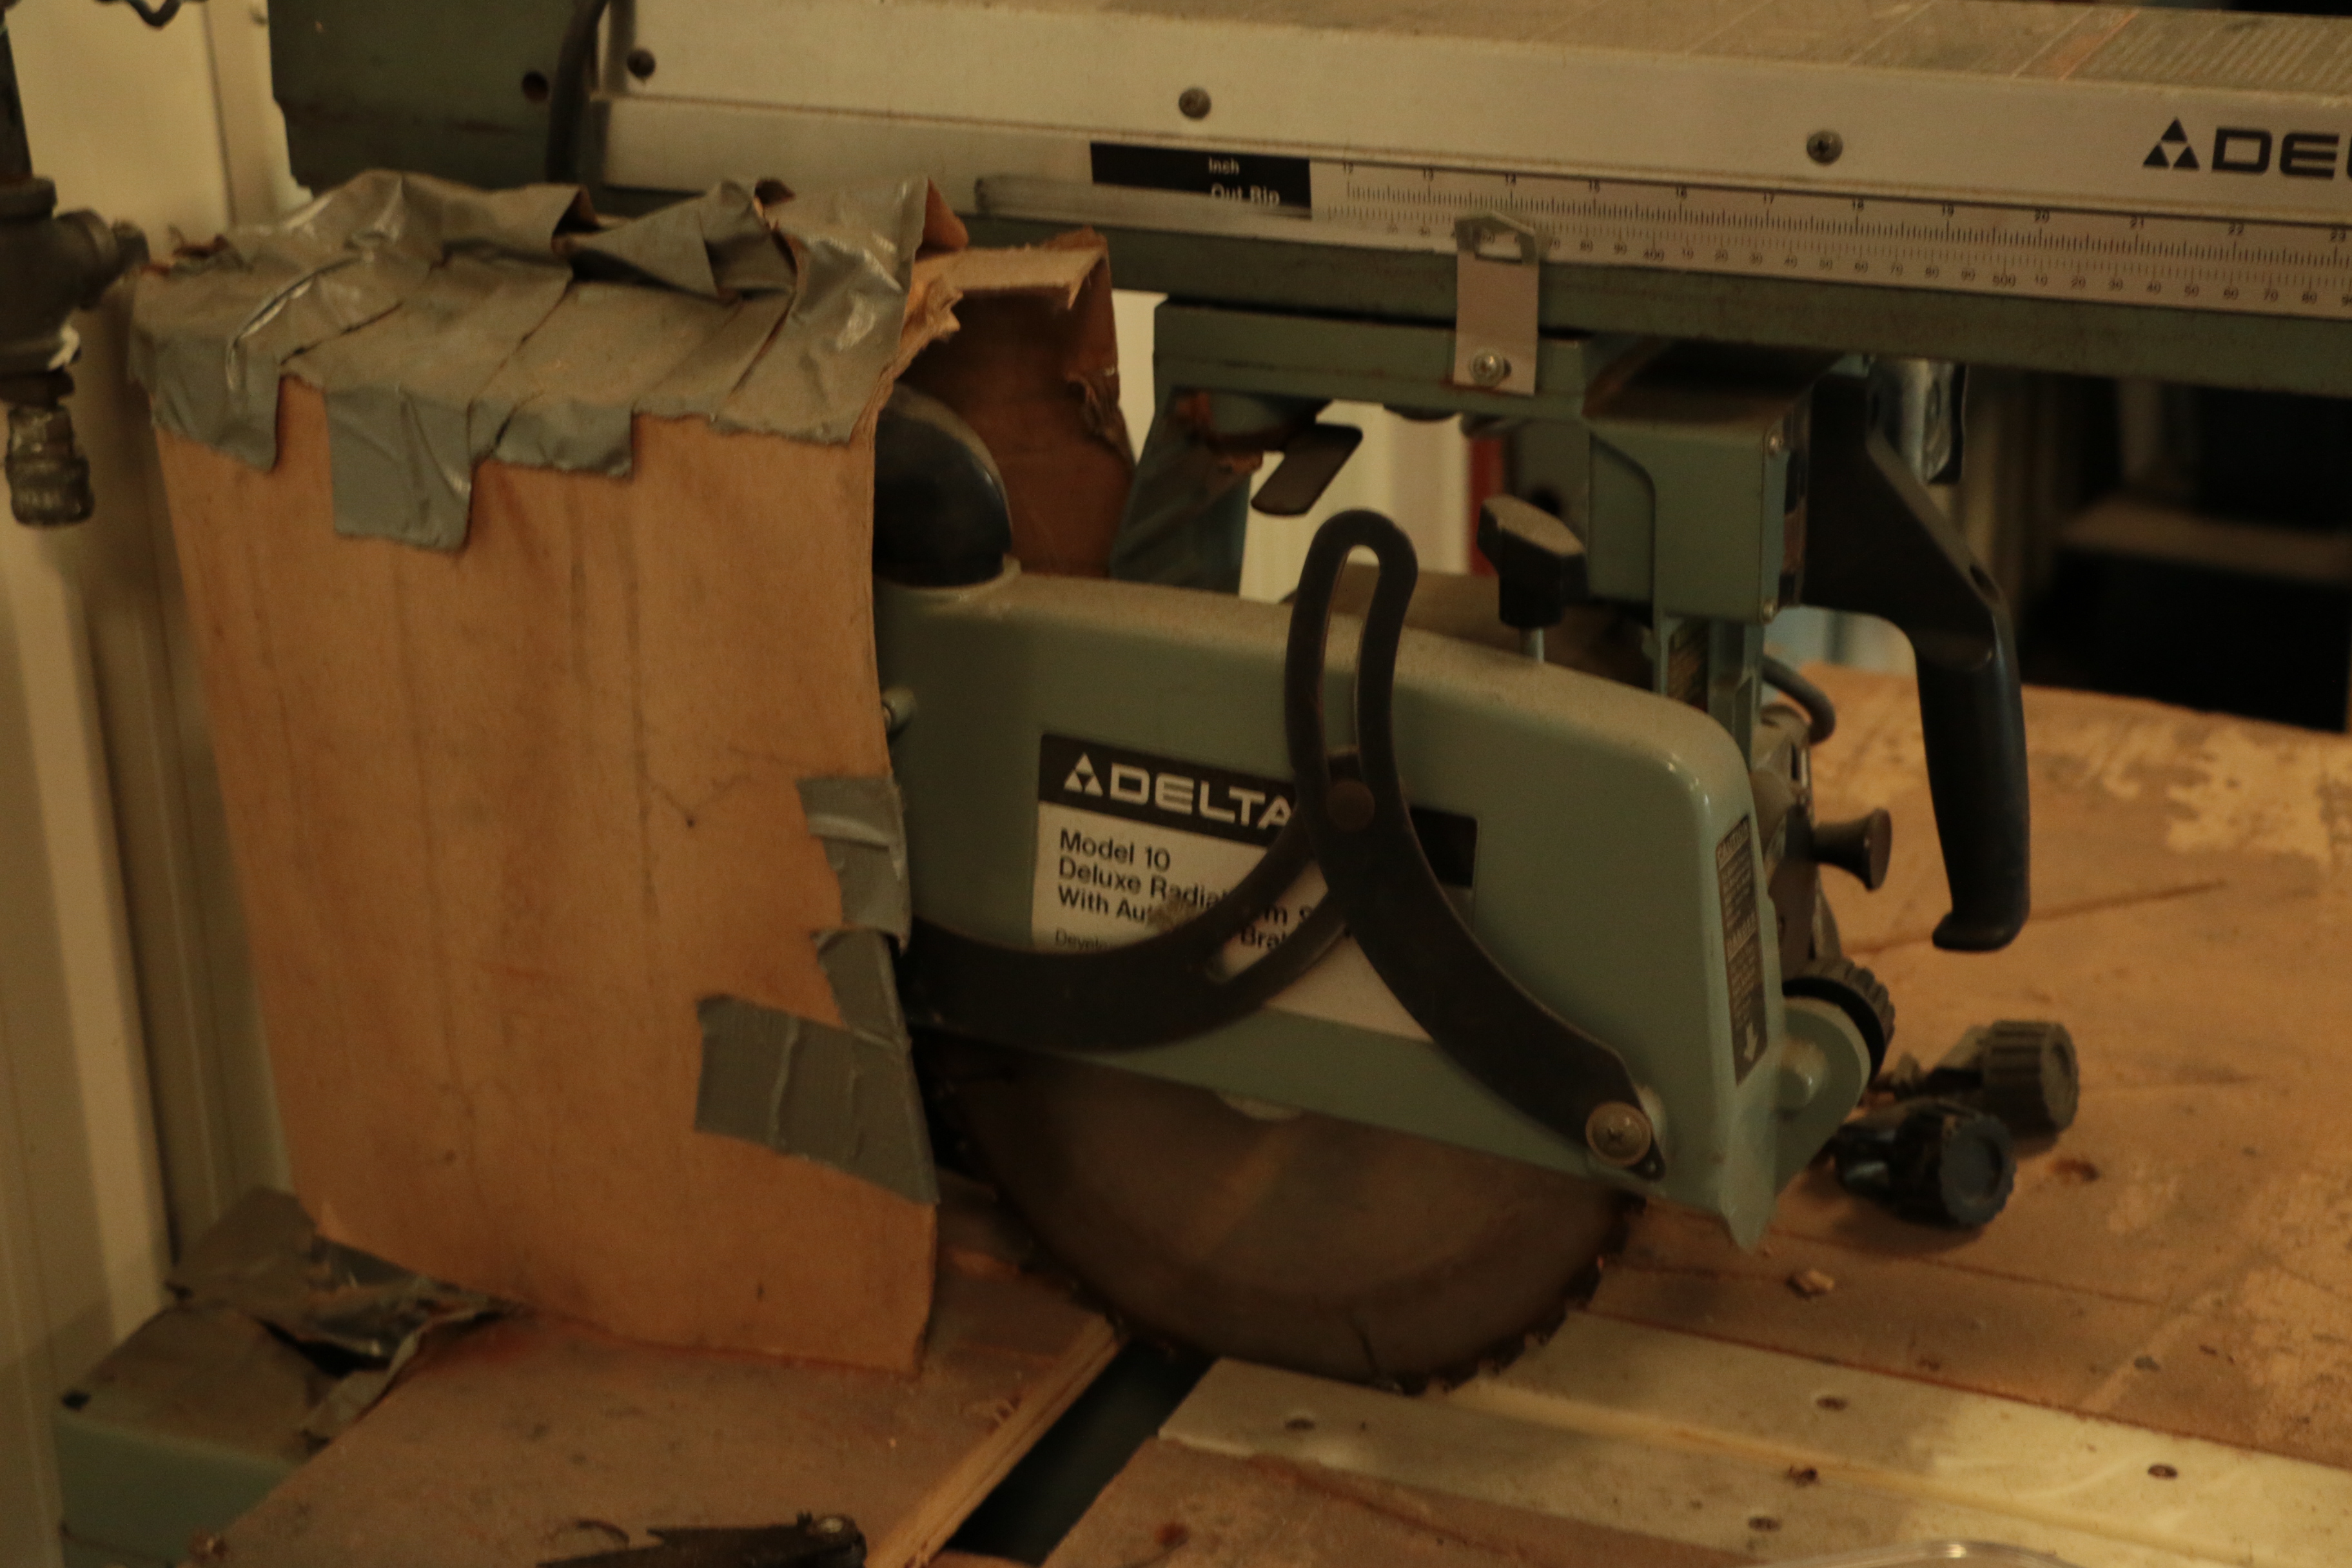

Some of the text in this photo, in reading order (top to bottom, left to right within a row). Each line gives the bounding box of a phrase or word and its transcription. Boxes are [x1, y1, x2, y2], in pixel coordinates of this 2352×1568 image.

[1209, 156, 1239, 175] Inch
[2211, 126, 2352, 181] DE
[1211, 182, 1242, 202] Out
[2034, 210, 2050, 224] 20
[2130, 215, 2144, 230] 21
[2228, 222, 2244, 237] 22
[1110, 762, 1291, 830] DELTA
[1060, 828, 1171, 873] Model 10
[1718, 820, 1748, 860] CAUTION
[1059, 856, 1141, 896] Deluxe
[1059, 884, 1109, 915] With
